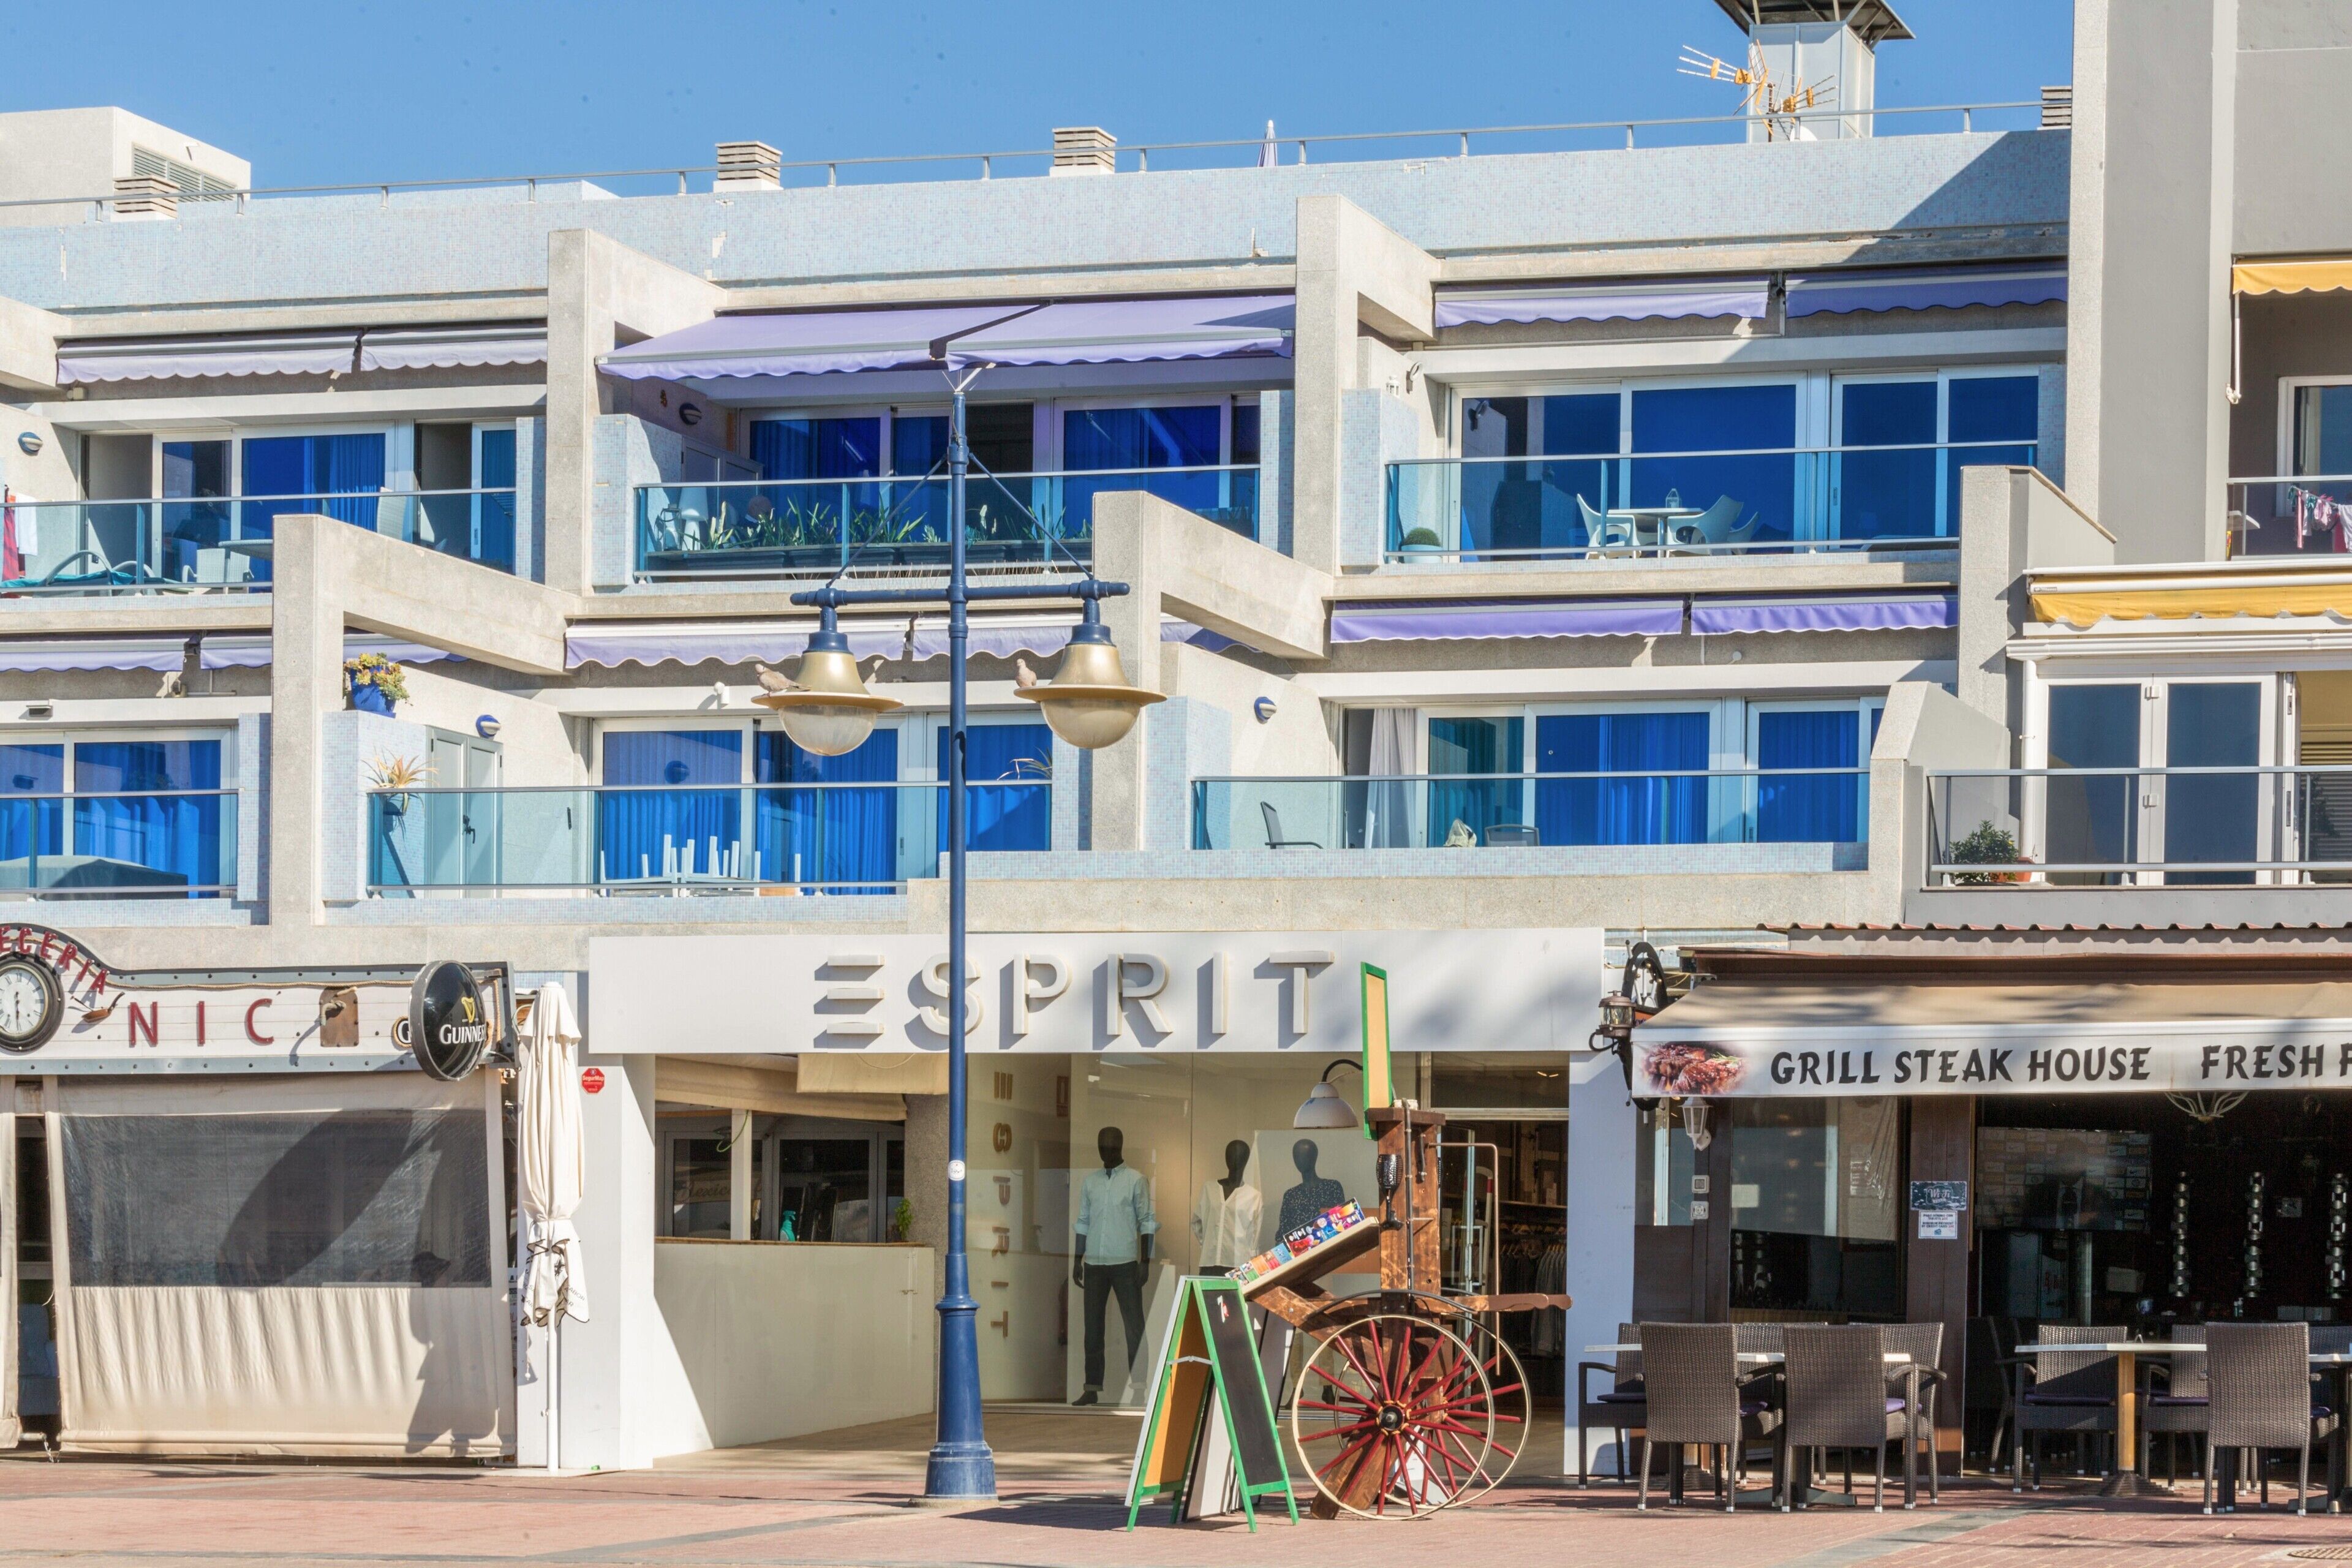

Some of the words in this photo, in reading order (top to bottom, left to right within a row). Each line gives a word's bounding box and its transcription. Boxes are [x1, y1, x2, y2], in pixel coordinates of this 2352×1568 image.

[826, 952, 1334, 1036] ESPRIT
[440, 1024, 486, 1044] GUINNES
[1770, 1050, 1880, 1085] GRILL
[1894, 1048, 2013, 1084] STEAK
[2027, 1046, 2152, 1082] HOUSE
[2201, 1044, 2324, 1080] FRESH
[990, 1071, 1014, 1338] ESPRIT
